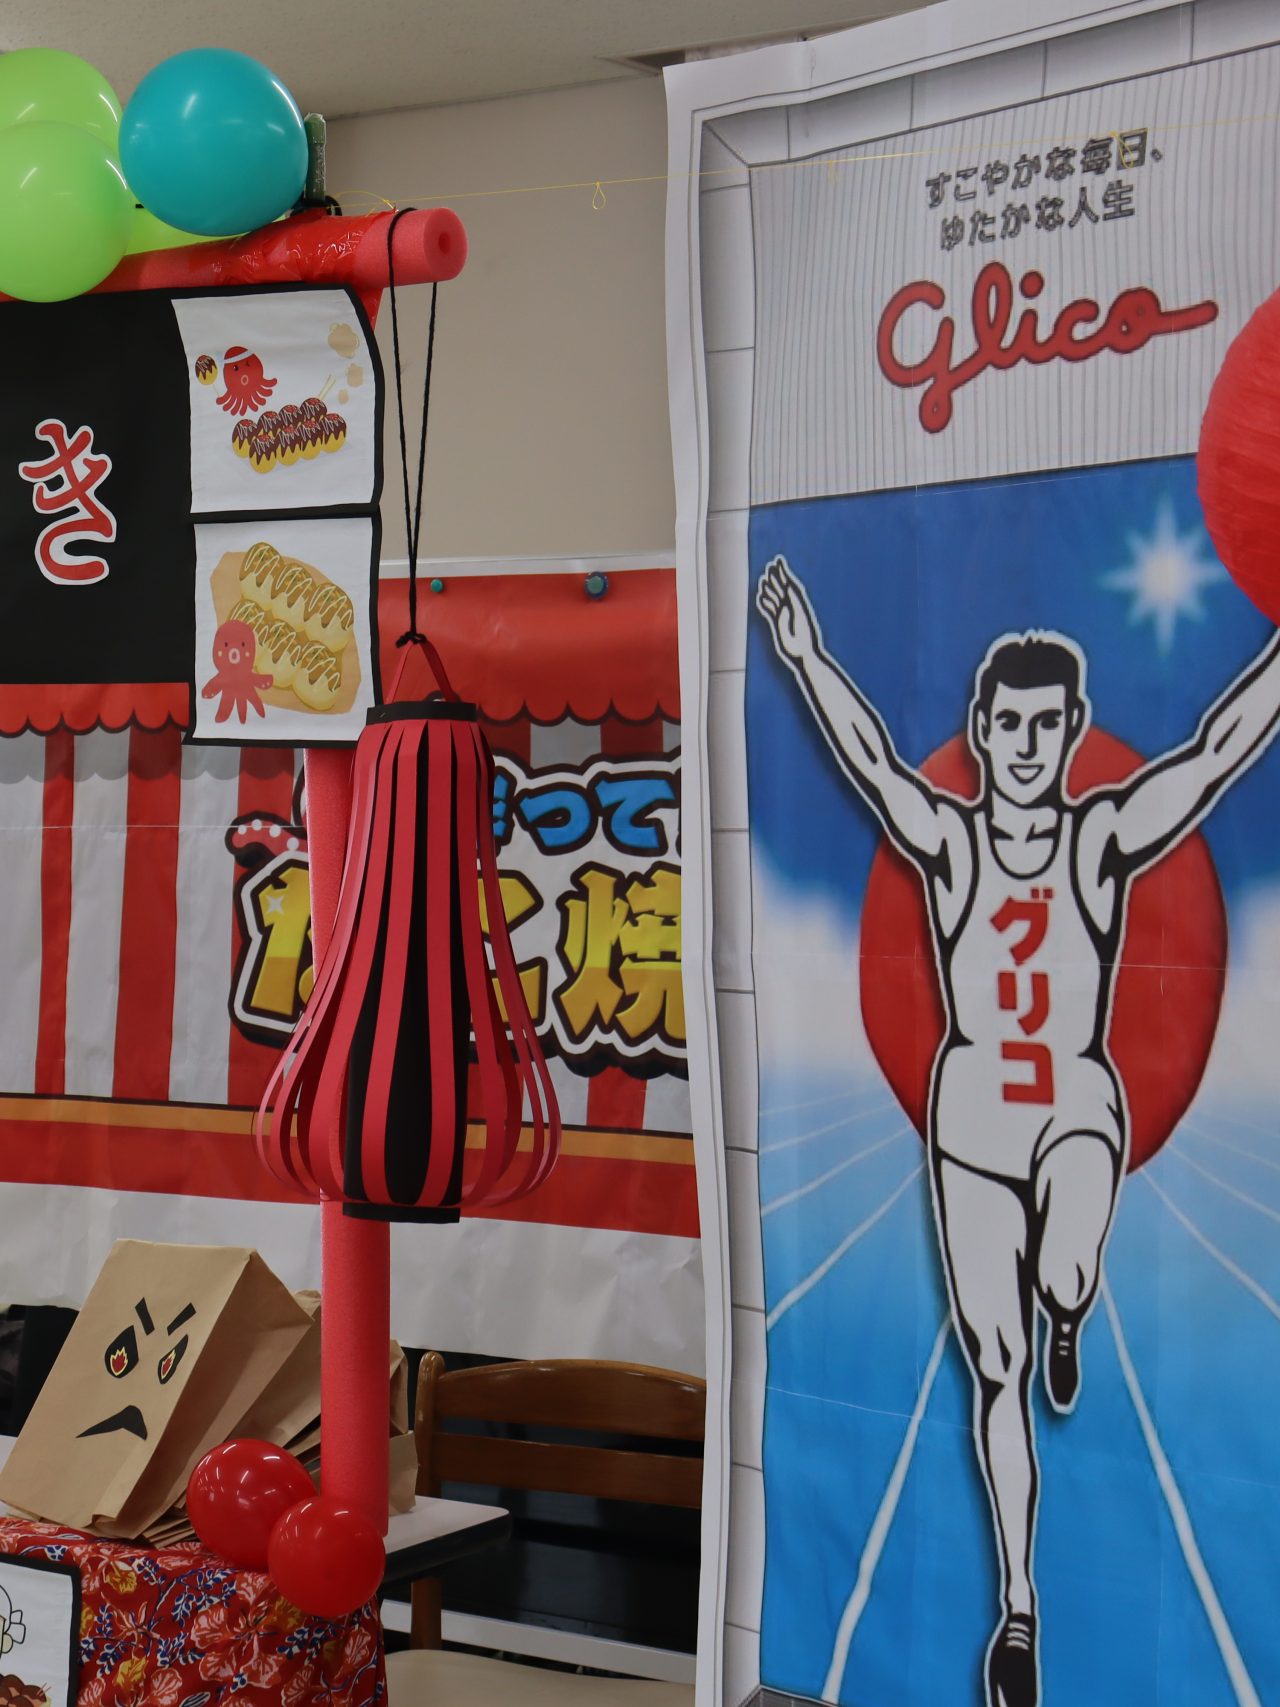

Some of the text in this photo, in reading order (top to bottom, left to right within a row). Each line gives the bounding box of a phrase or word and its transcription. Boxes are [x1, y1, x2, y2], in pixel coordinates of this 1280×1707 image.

[925, 128, 1163, 209] すこやかな毎日、
[939, 180, 1136, 251] ゆたかな人生
[877, 260, 1219, 434] Glico
[989, 886, 1055, 1106] グリコ
